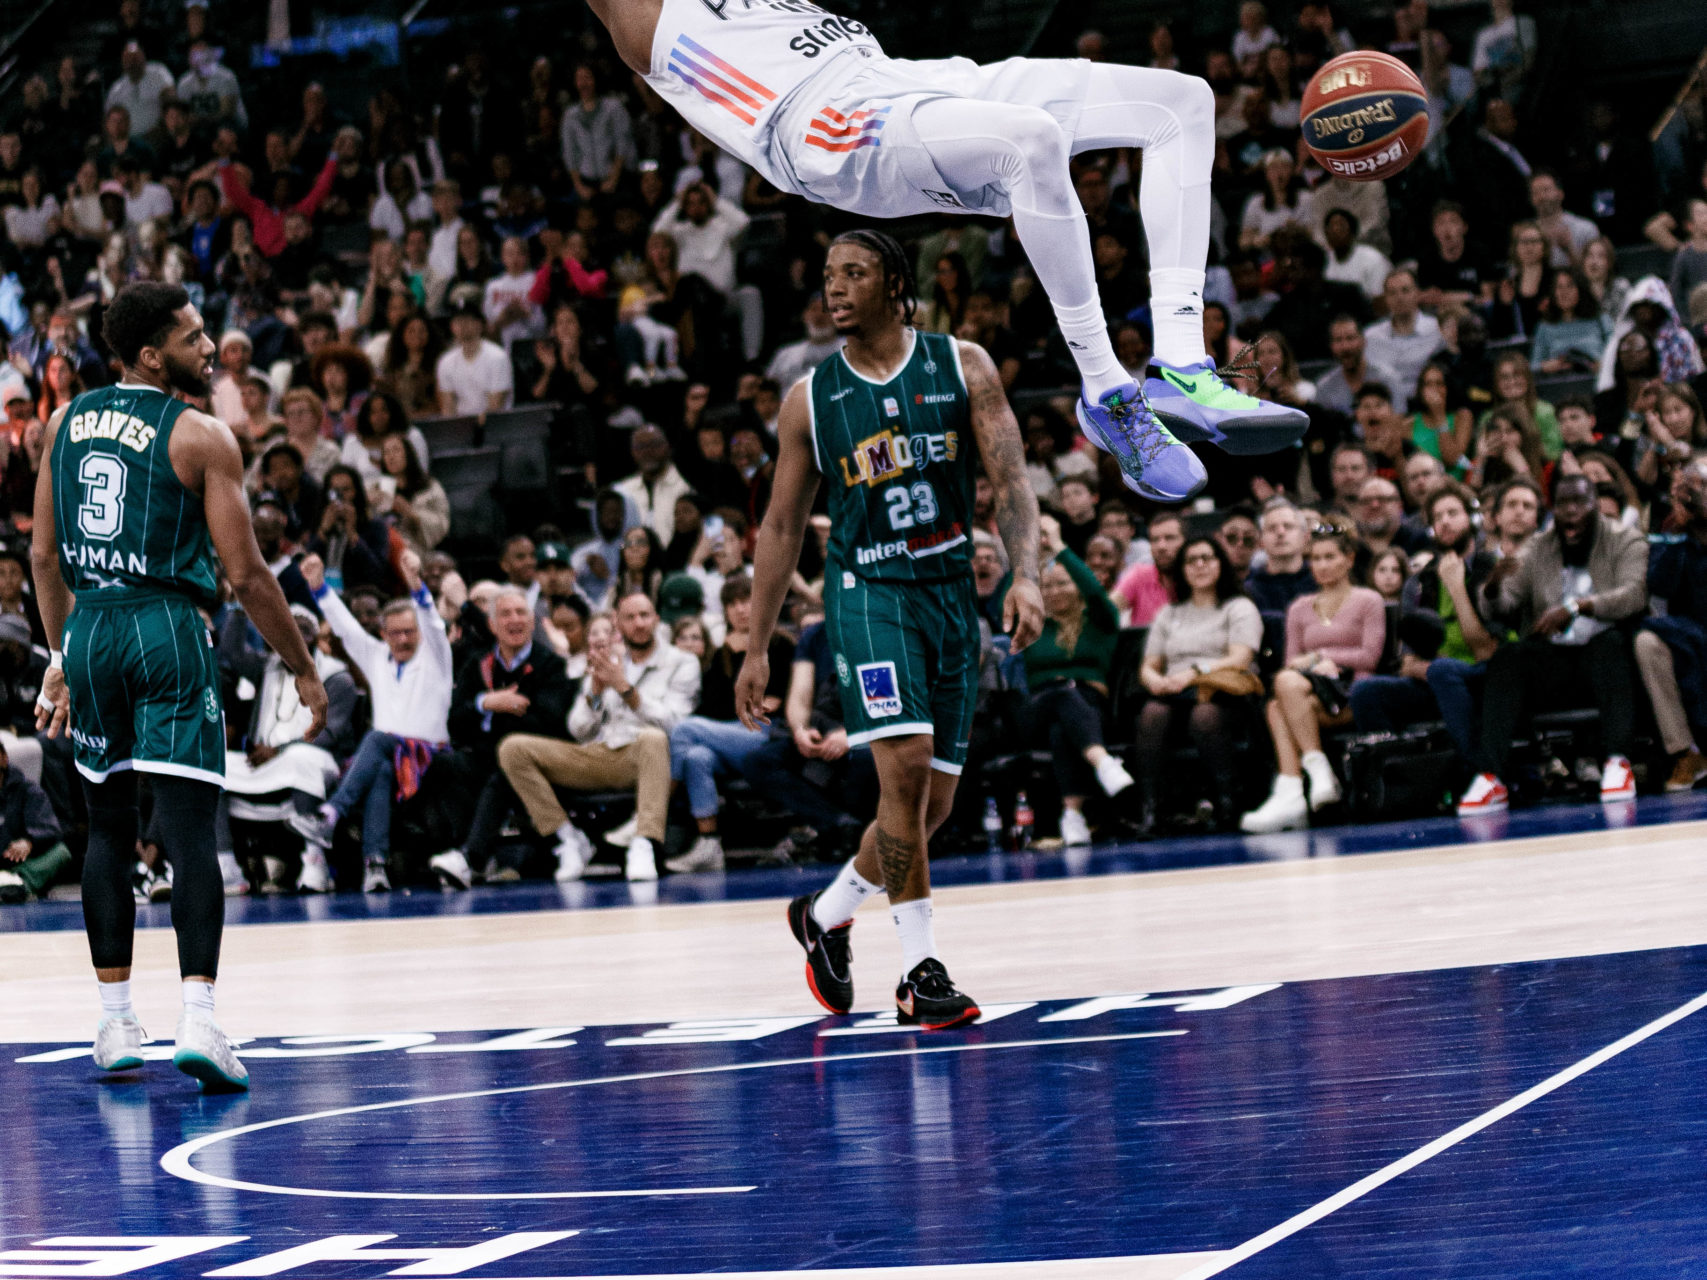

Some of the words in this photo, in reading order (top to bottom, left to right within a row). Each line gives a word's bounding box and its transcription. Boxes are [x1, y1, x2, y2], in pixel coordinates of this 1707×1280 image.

[1312, 98, 1397, 139] SPALDING
[1333, 141, 1402, 176] Betclic
[70, 410, 156, 453] GRAVES
[78, 450, 128, 541] 3
[884, 481, 940, 531] 23
